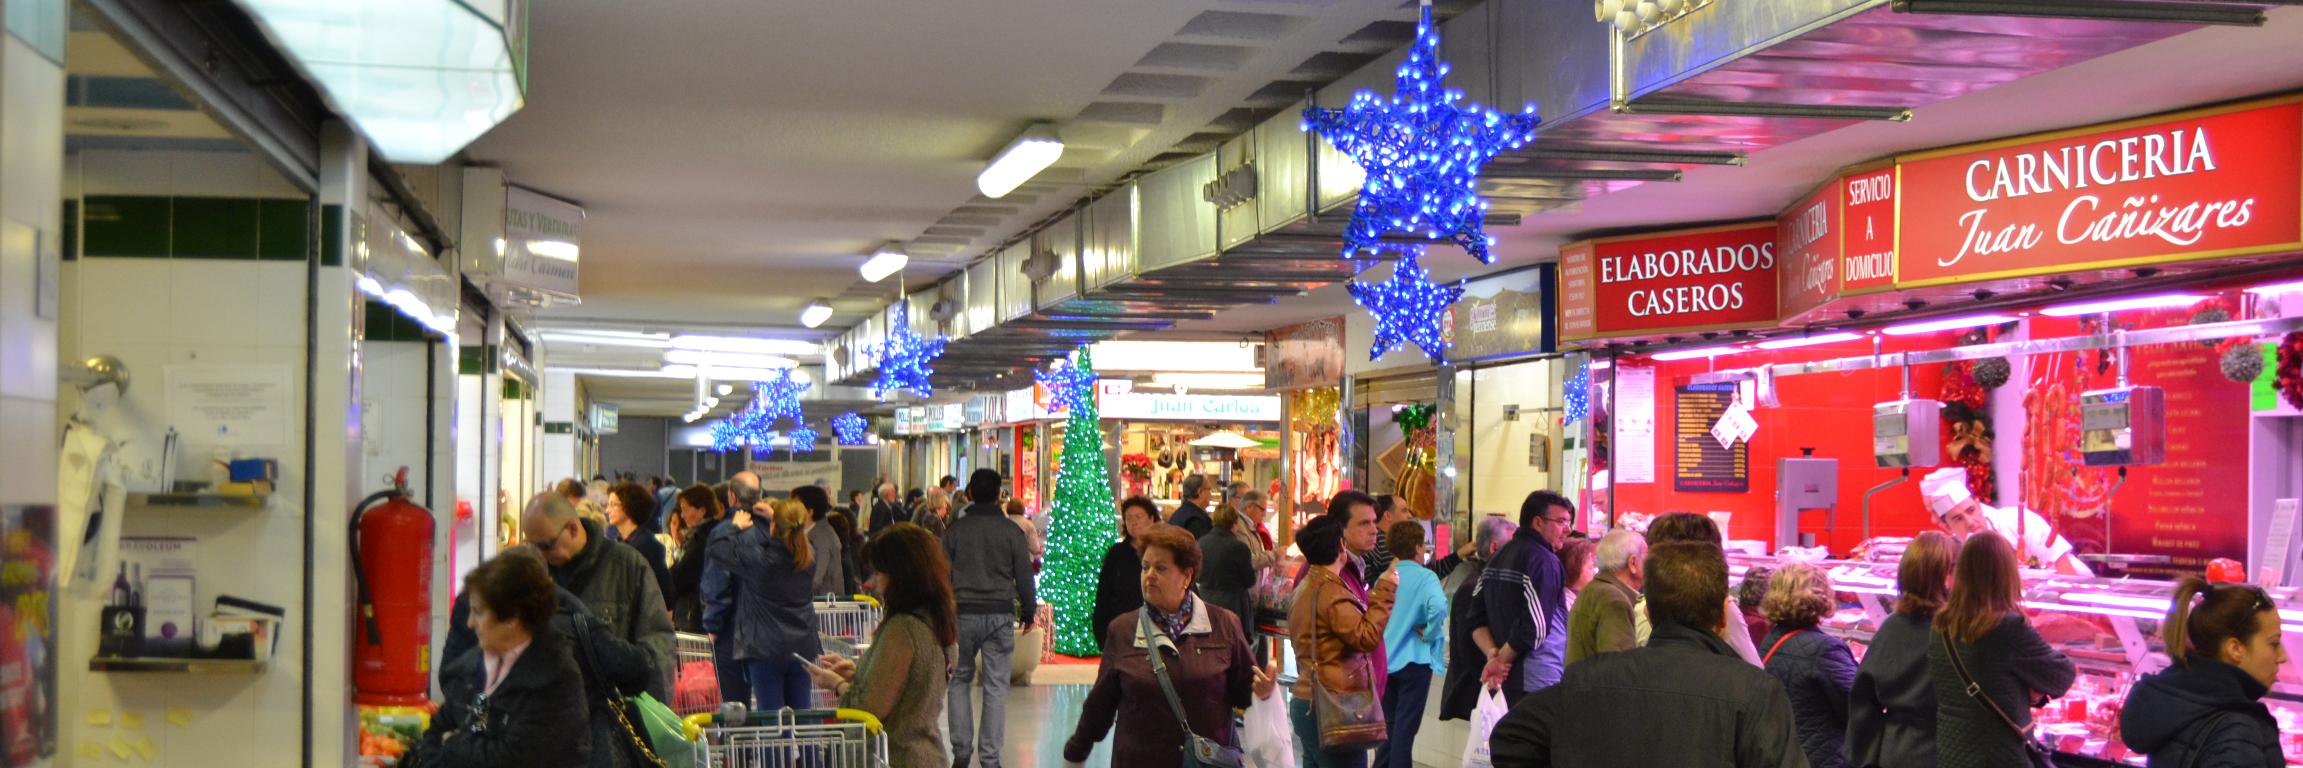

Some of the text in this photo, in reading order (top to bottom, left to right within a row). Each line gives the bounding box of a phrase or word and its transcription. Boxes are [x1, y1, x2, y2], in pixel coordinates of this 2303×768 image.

[1965, 126, 2217, 202] CARNICERIA
[1848, 174, 1891, 206] SERVICIO
[1865, 215, 1875, 240] A
[1937, 194, 2254, 267] Juan Cañizares
[1600, 242, 1775, 283] ELABORADOS
[1845, 250, 1895, 282] DOMICILIO
[1627, 281, 1744, 317] CASEROS
[1151, 399, 1193, 415] Juan
